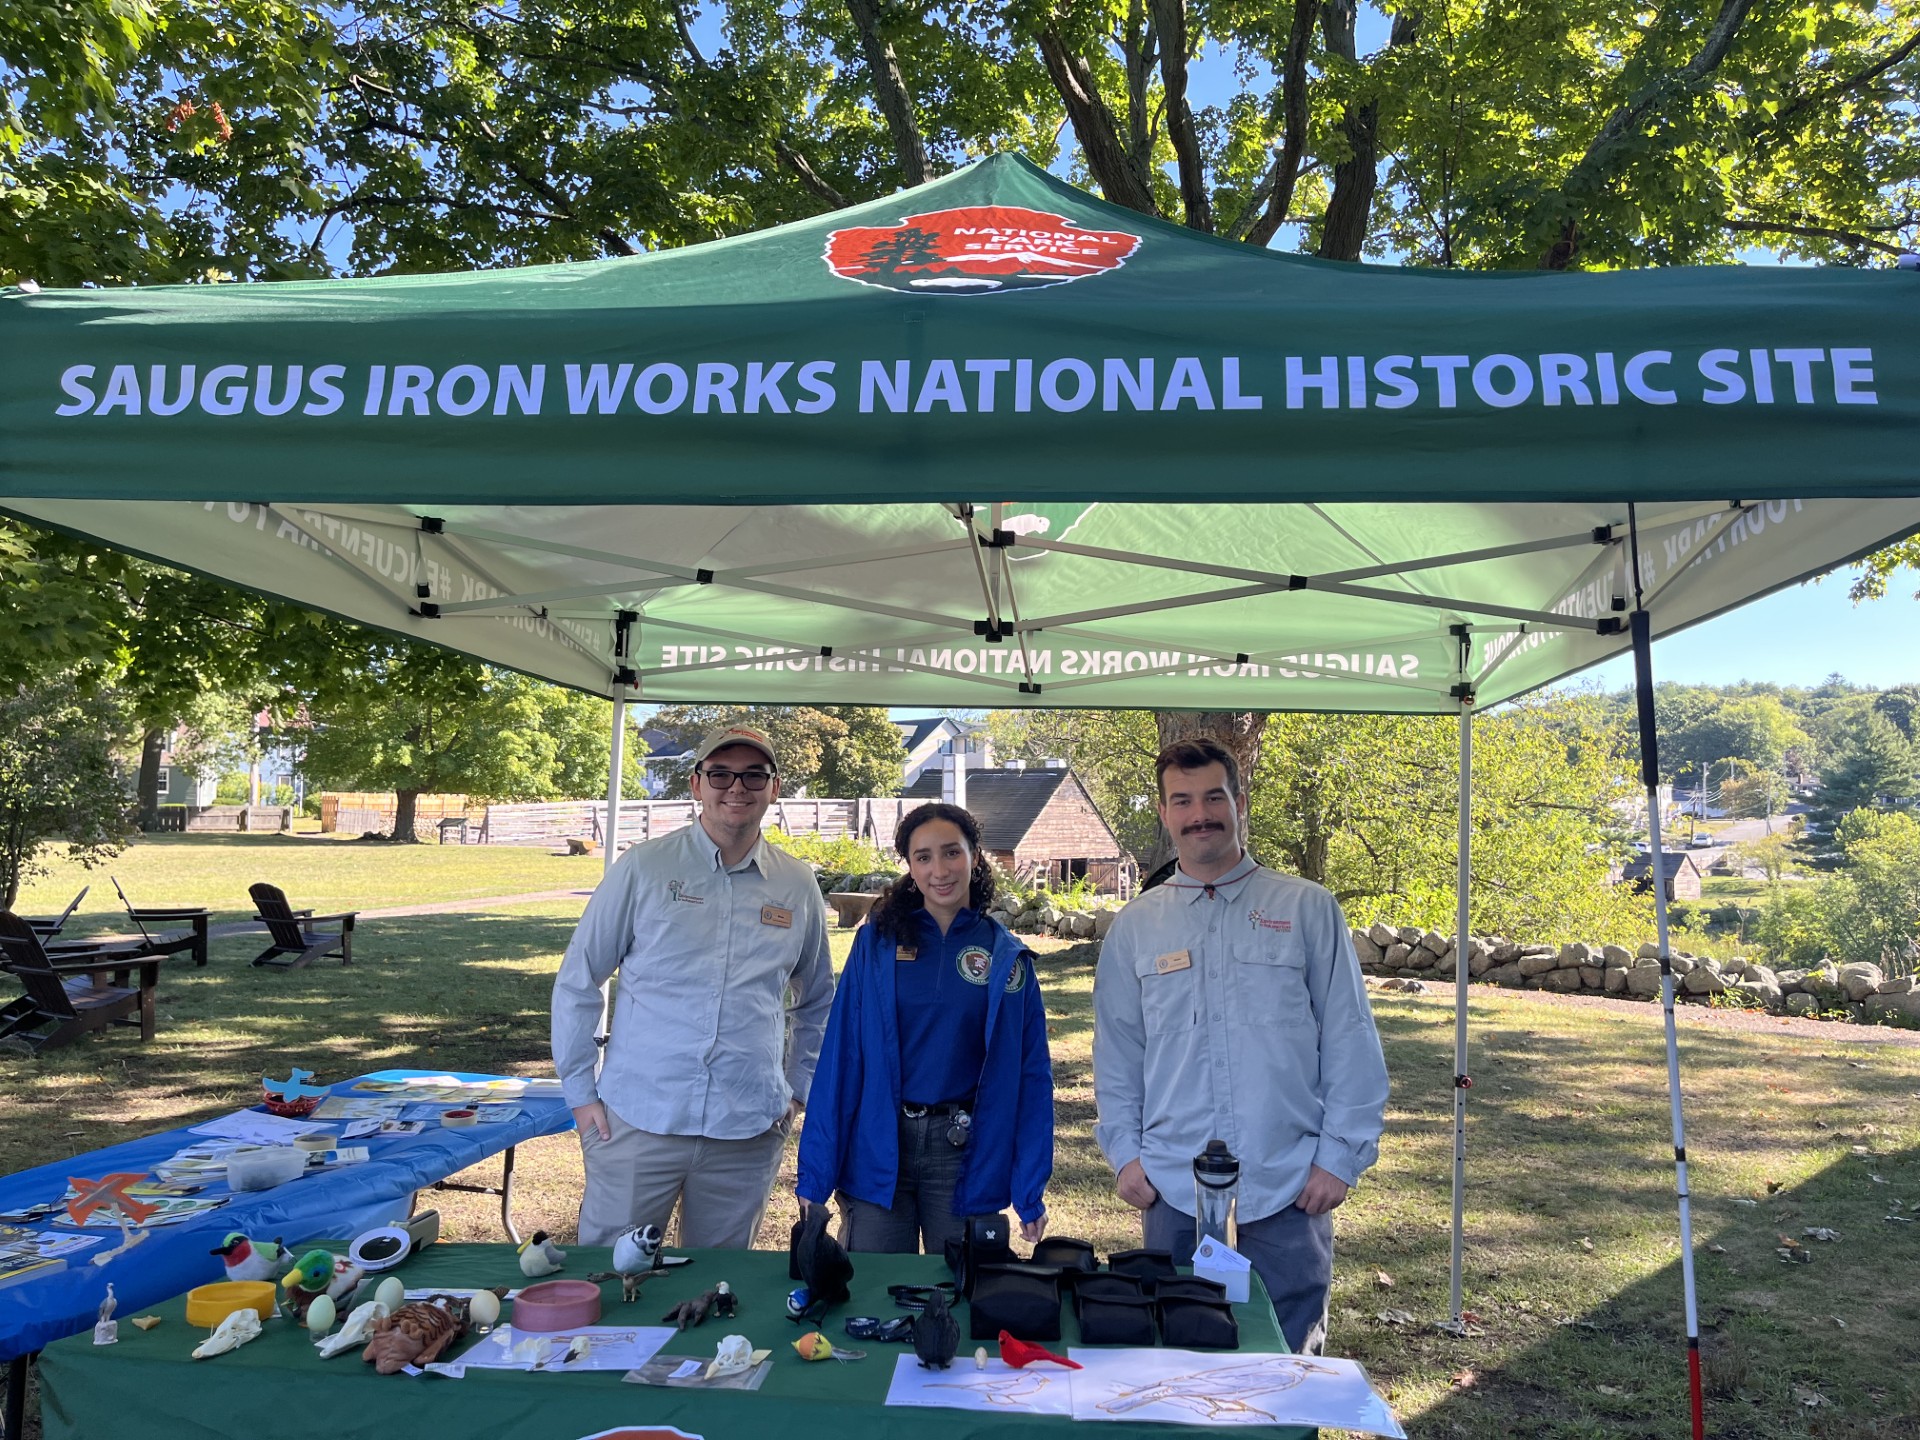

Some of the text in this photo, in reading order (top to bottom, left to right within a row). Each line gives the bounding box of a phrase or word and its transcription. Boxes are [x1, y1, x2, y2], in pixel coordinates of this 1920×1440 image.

[953, 227, 1118, 245] NATIONAL
[990, 236, 1075, 248] PARK
[964, 243, 1099, 256] SERVICE
[55, 347, 1879, 417] SAUGUS IRON WORKS NATIONAL HISTORIC SITE
